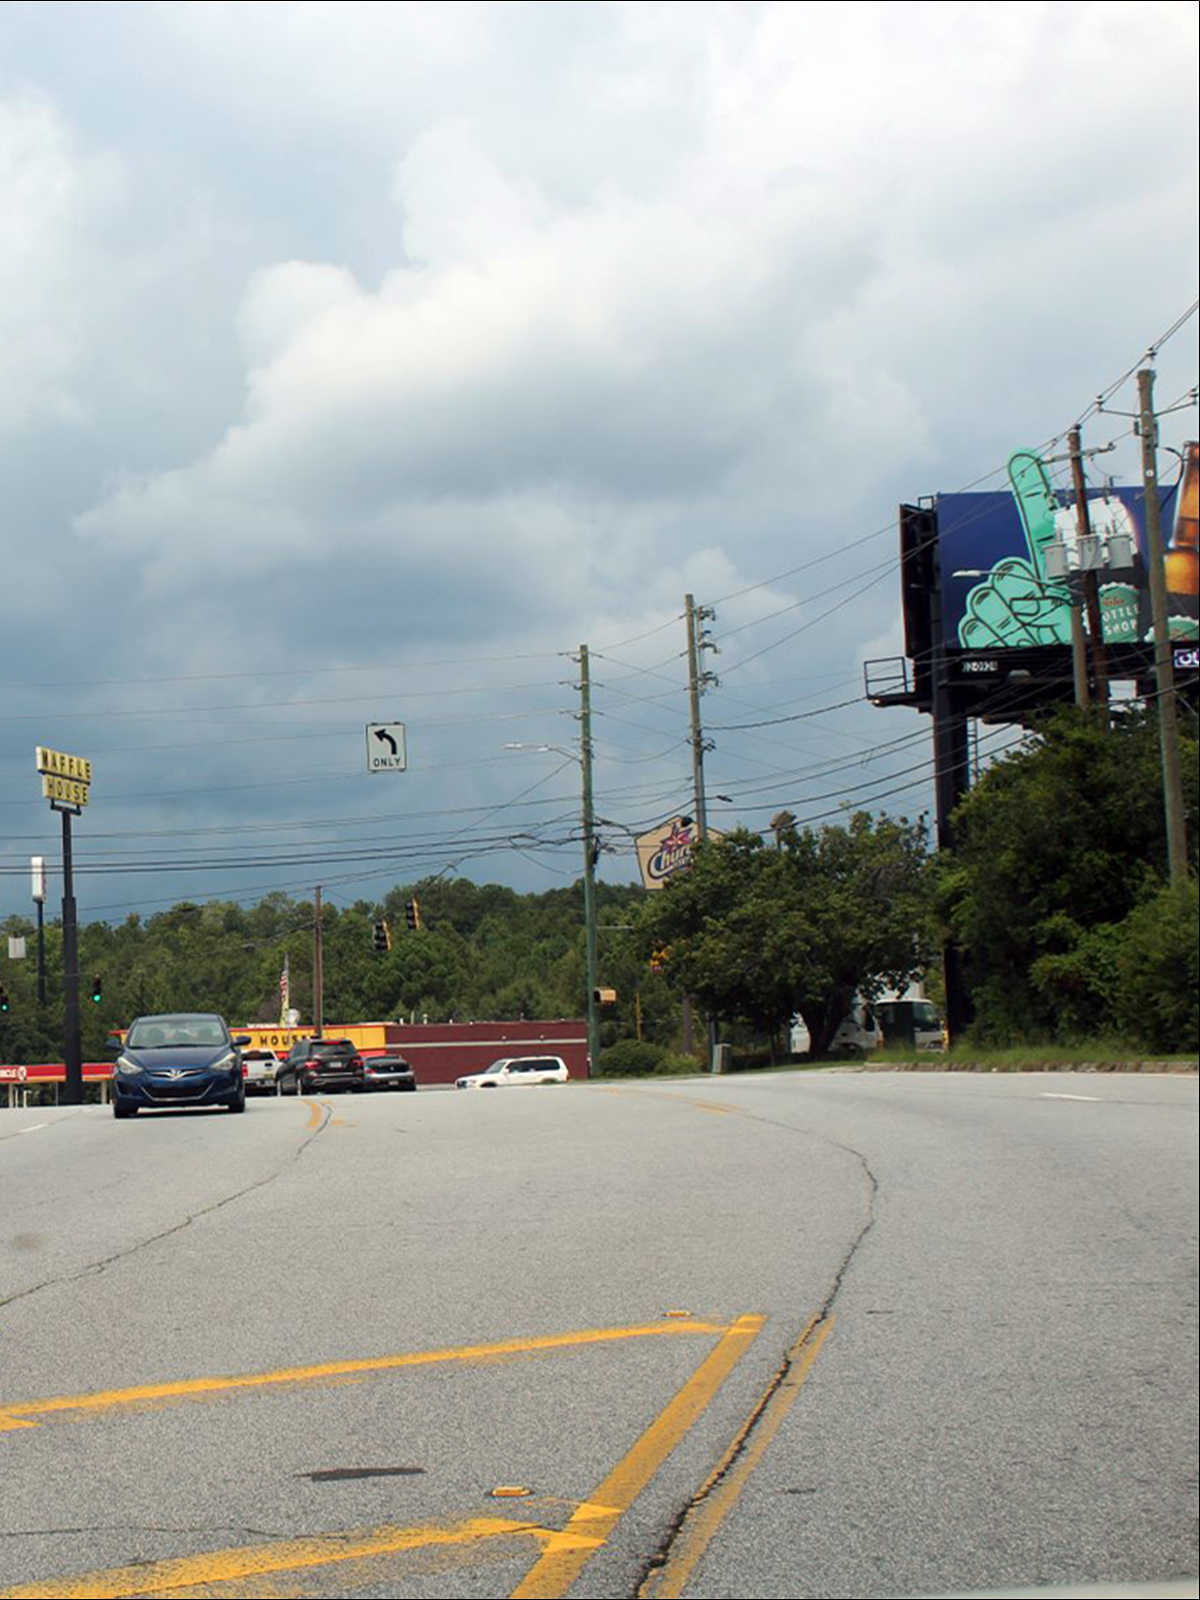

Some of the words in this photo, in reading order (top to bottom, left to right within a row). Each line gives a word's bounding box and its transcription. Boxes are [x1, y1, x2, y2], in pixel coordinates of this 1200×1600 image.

[41, 749, 90, 780] WAFFLE
[373, 757, 401, 768] ONLY
[47, 778, 87, 803] HOUSE
